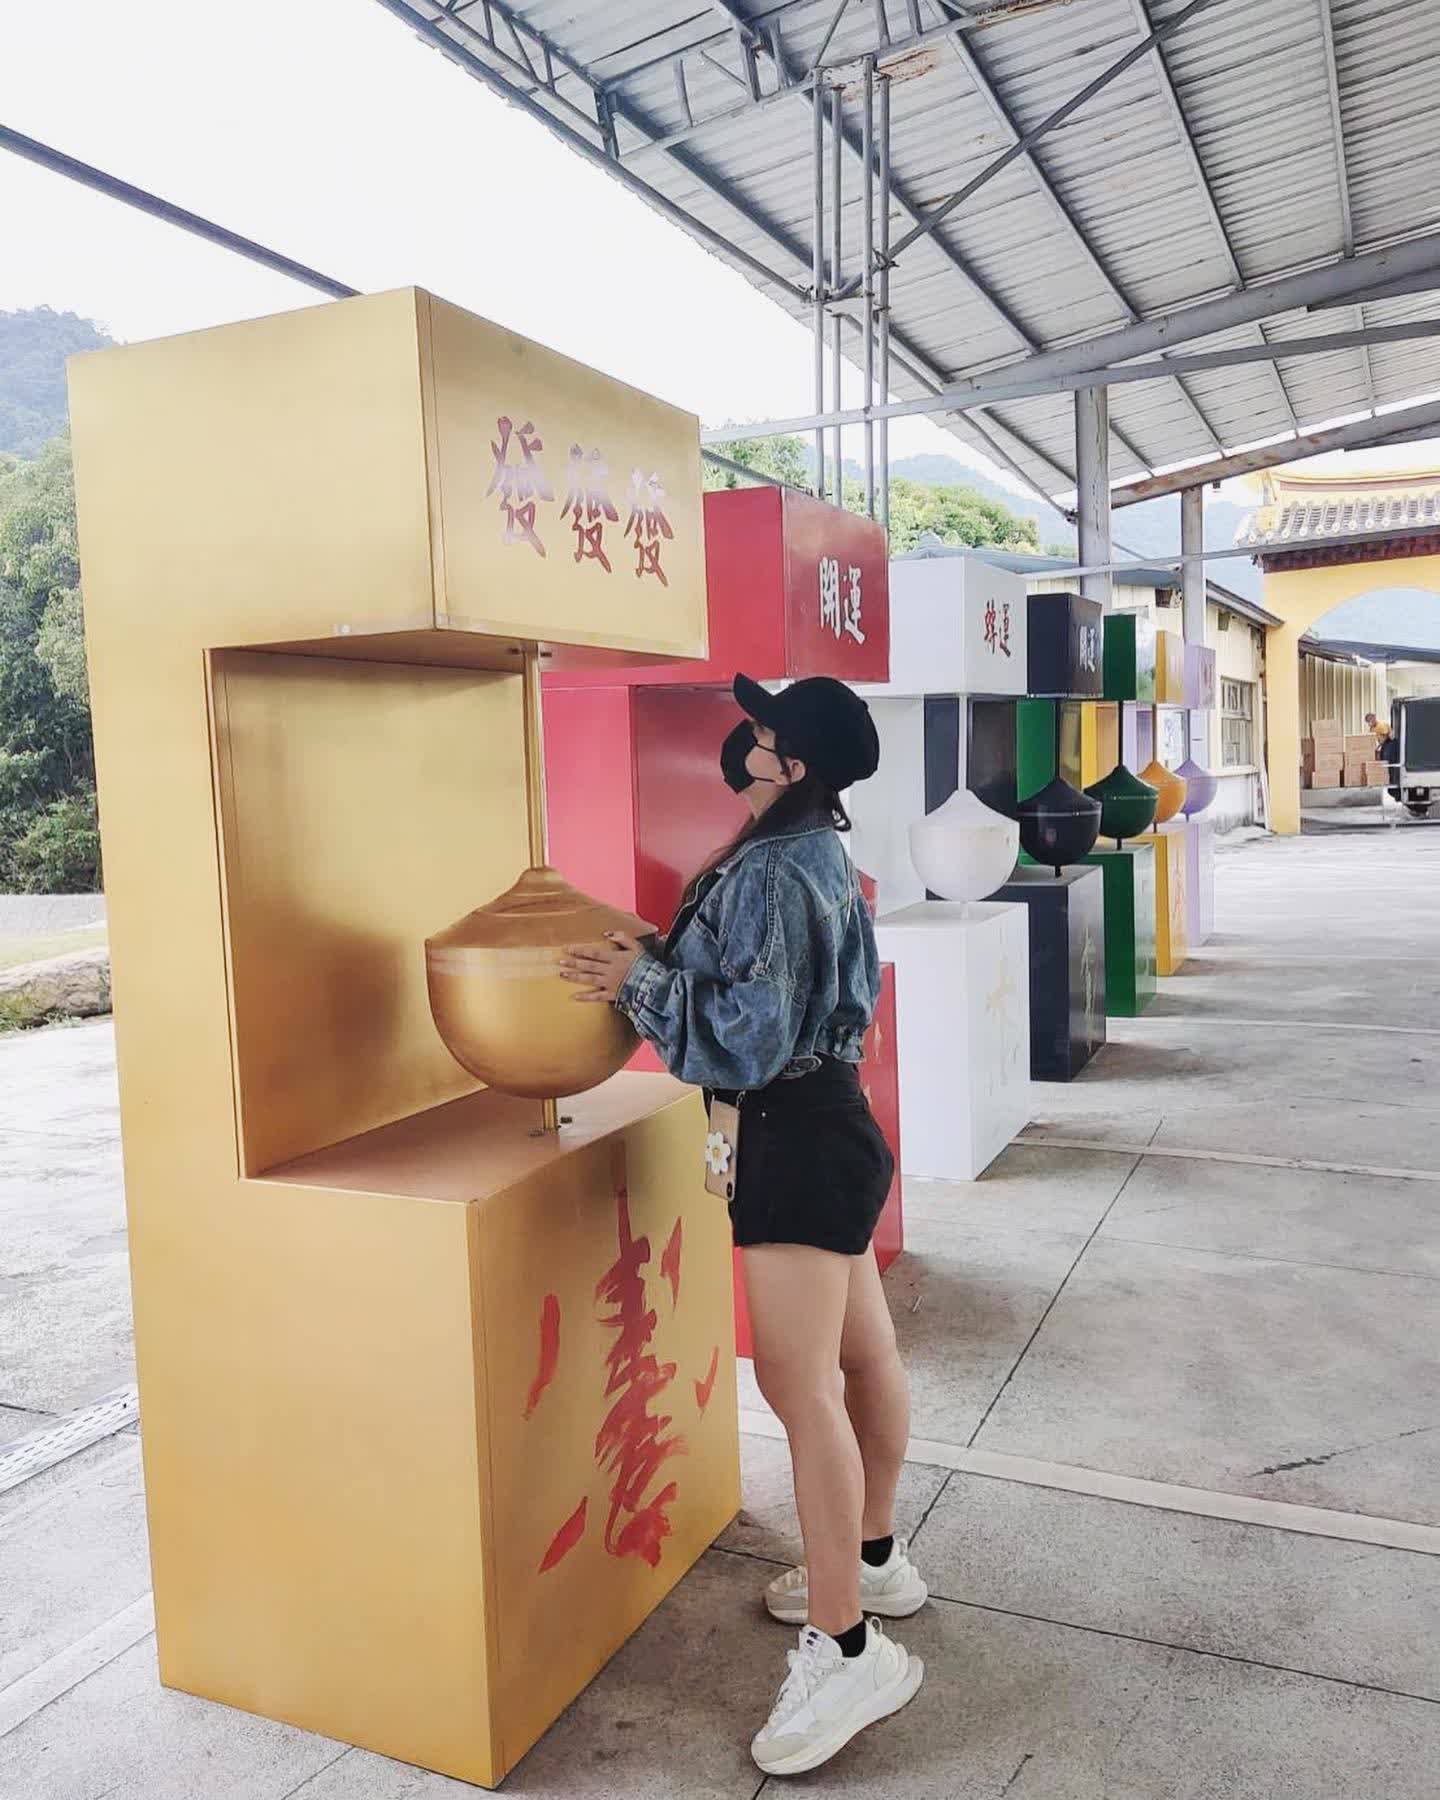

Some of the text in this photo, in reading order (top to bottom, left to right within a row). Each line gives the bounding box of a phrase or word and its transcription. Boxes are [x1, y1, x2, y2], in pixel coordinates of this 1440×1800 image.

[486, 416, 674, 587] 發發發
[819, 556, 866, 645] 開運
